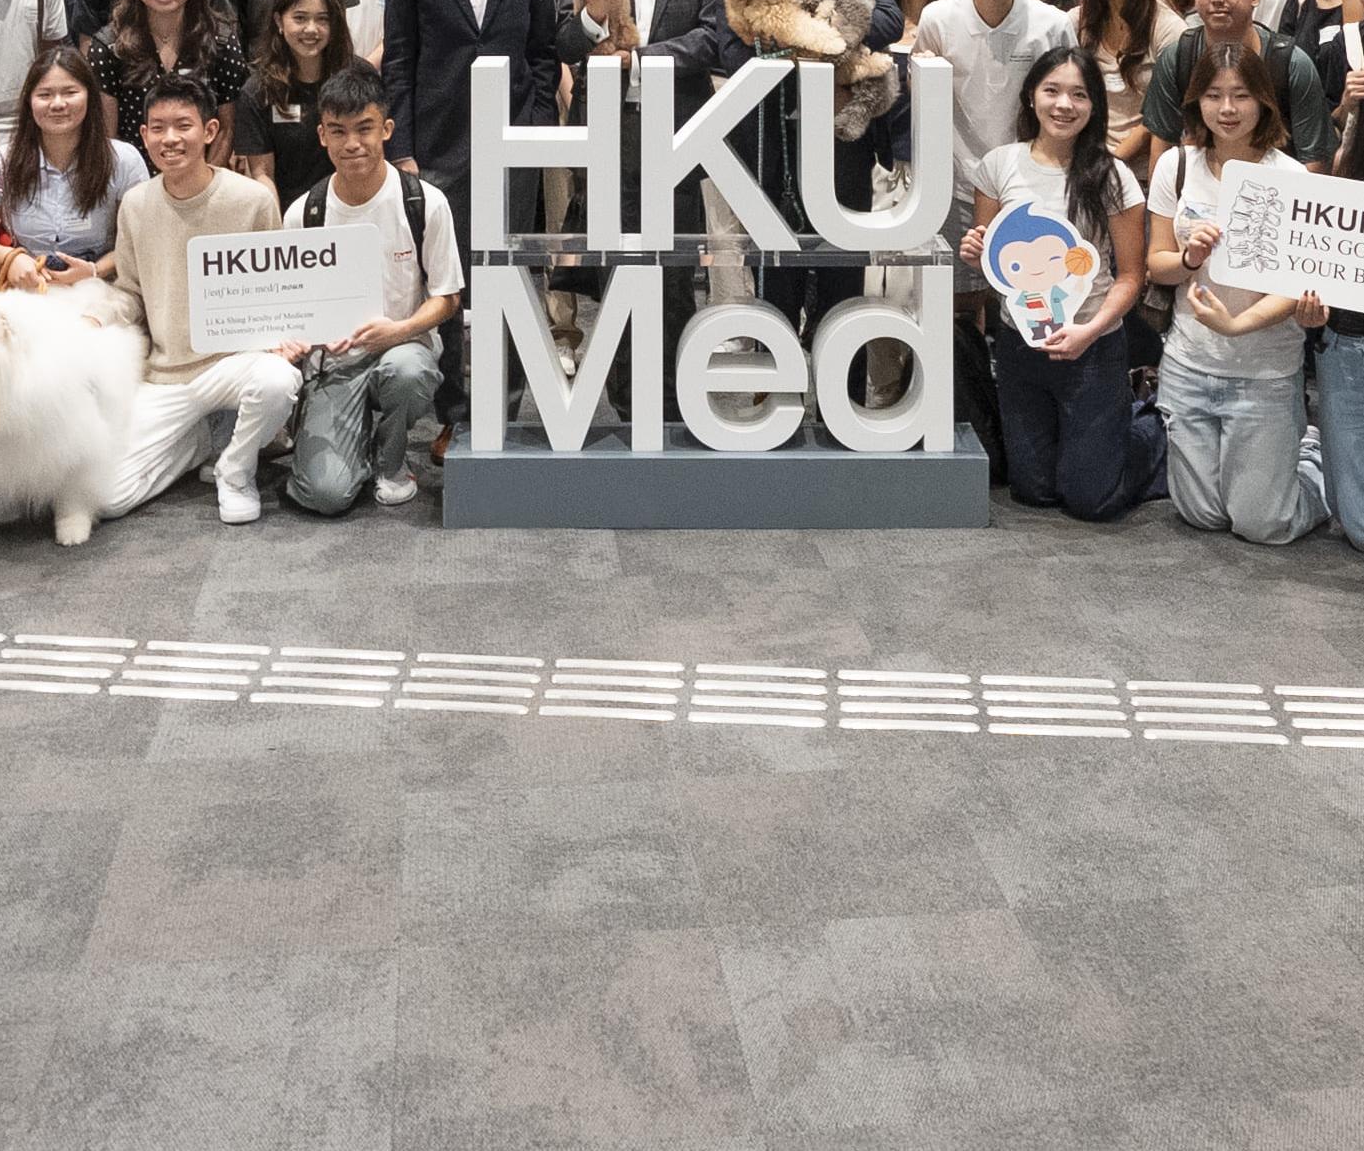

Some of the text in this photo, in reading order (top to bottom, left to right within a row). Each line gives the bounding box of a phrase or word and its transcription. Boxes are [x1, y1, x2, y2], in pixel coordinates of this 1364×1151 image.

[471, 56, 954, 251] HKU
[1288, 230, 1332, 253] HAS
[202, 242, 337, 277] HKUMed
[1287, 254, 1347, 282] YOUR
[281, 283, 304, 291] noun
[206, 328, 219, 337] The
[471, 265, 954, 452] Med
